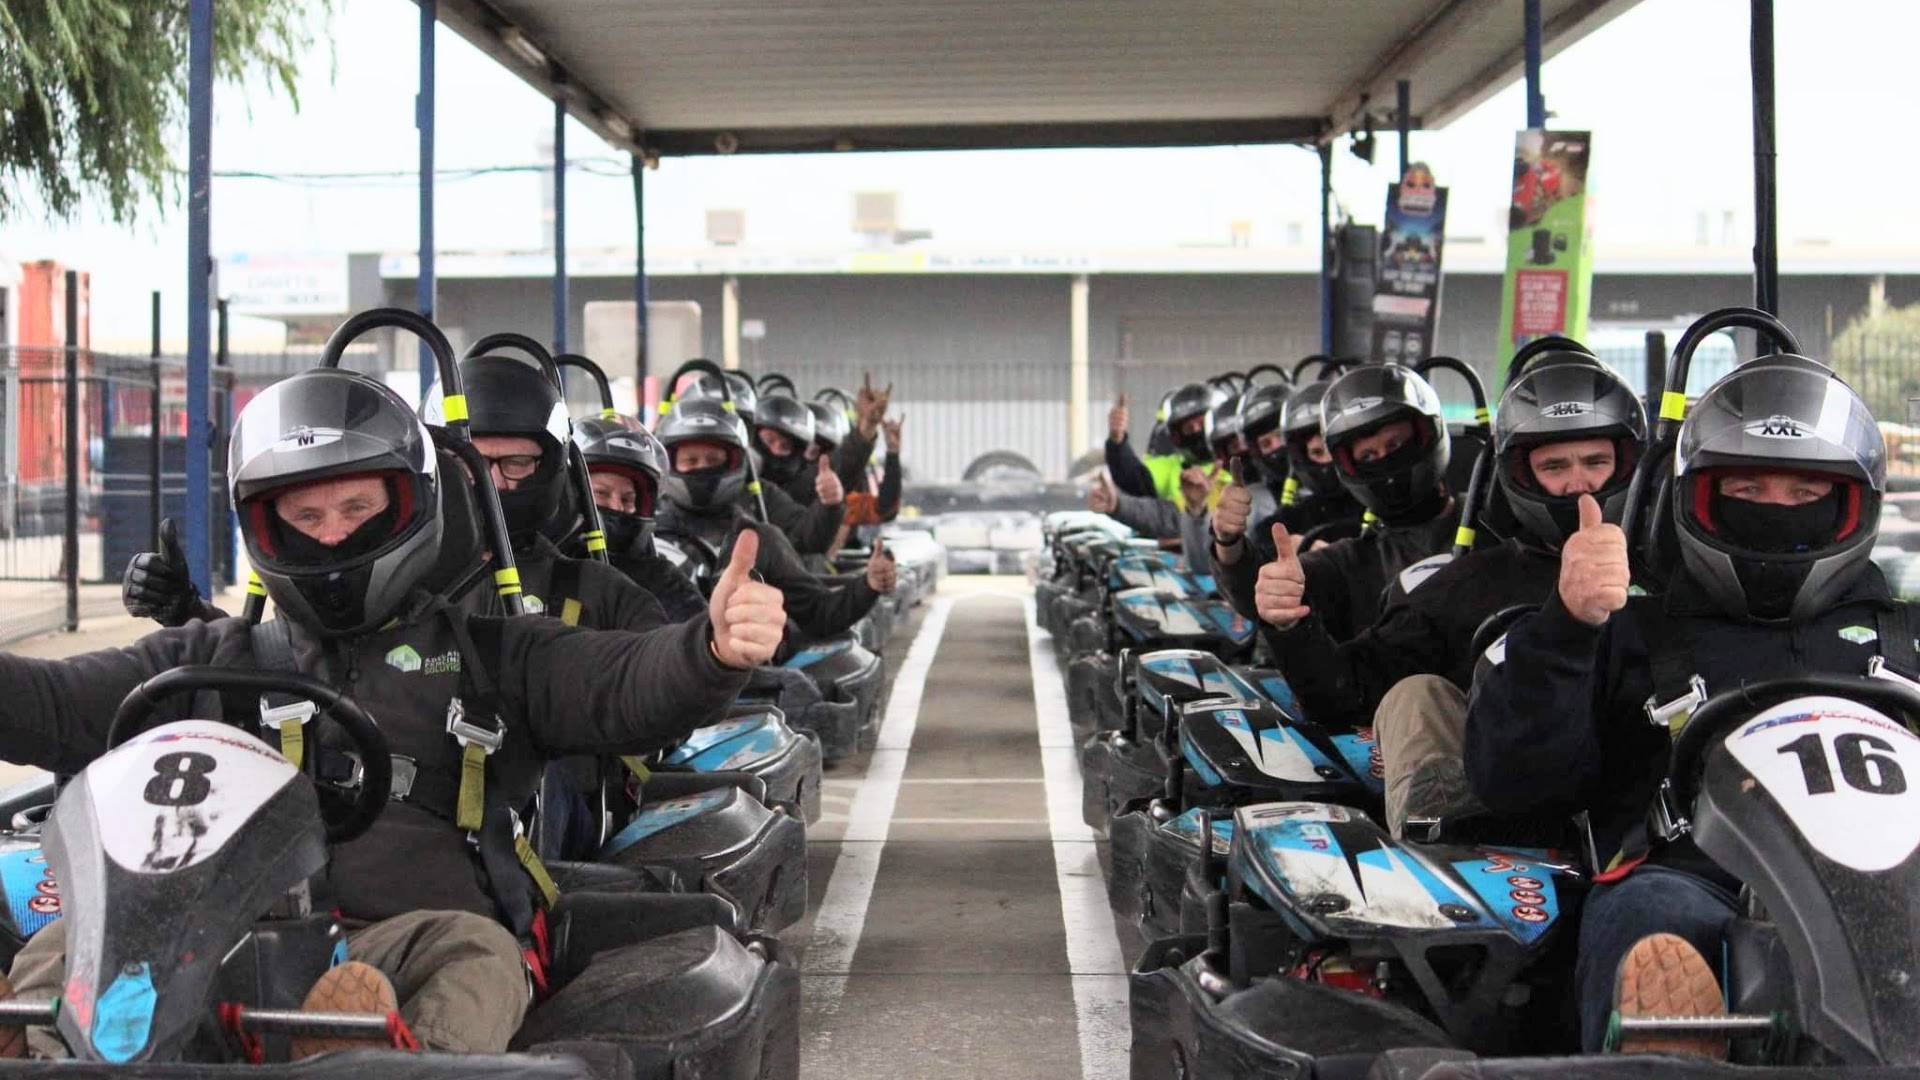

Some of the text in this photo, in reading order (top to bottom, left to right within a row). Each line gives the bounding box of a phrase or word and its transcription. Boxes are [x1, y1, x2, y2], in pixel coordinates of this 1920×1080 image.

[1553, 403, 1583, 415] XXL
[1761, 421, 1802, 437] XXL
[298, 434, 315, 446] M
[1777, 732, 1907, 795] 16
[143, 751, 217, 806] 8
